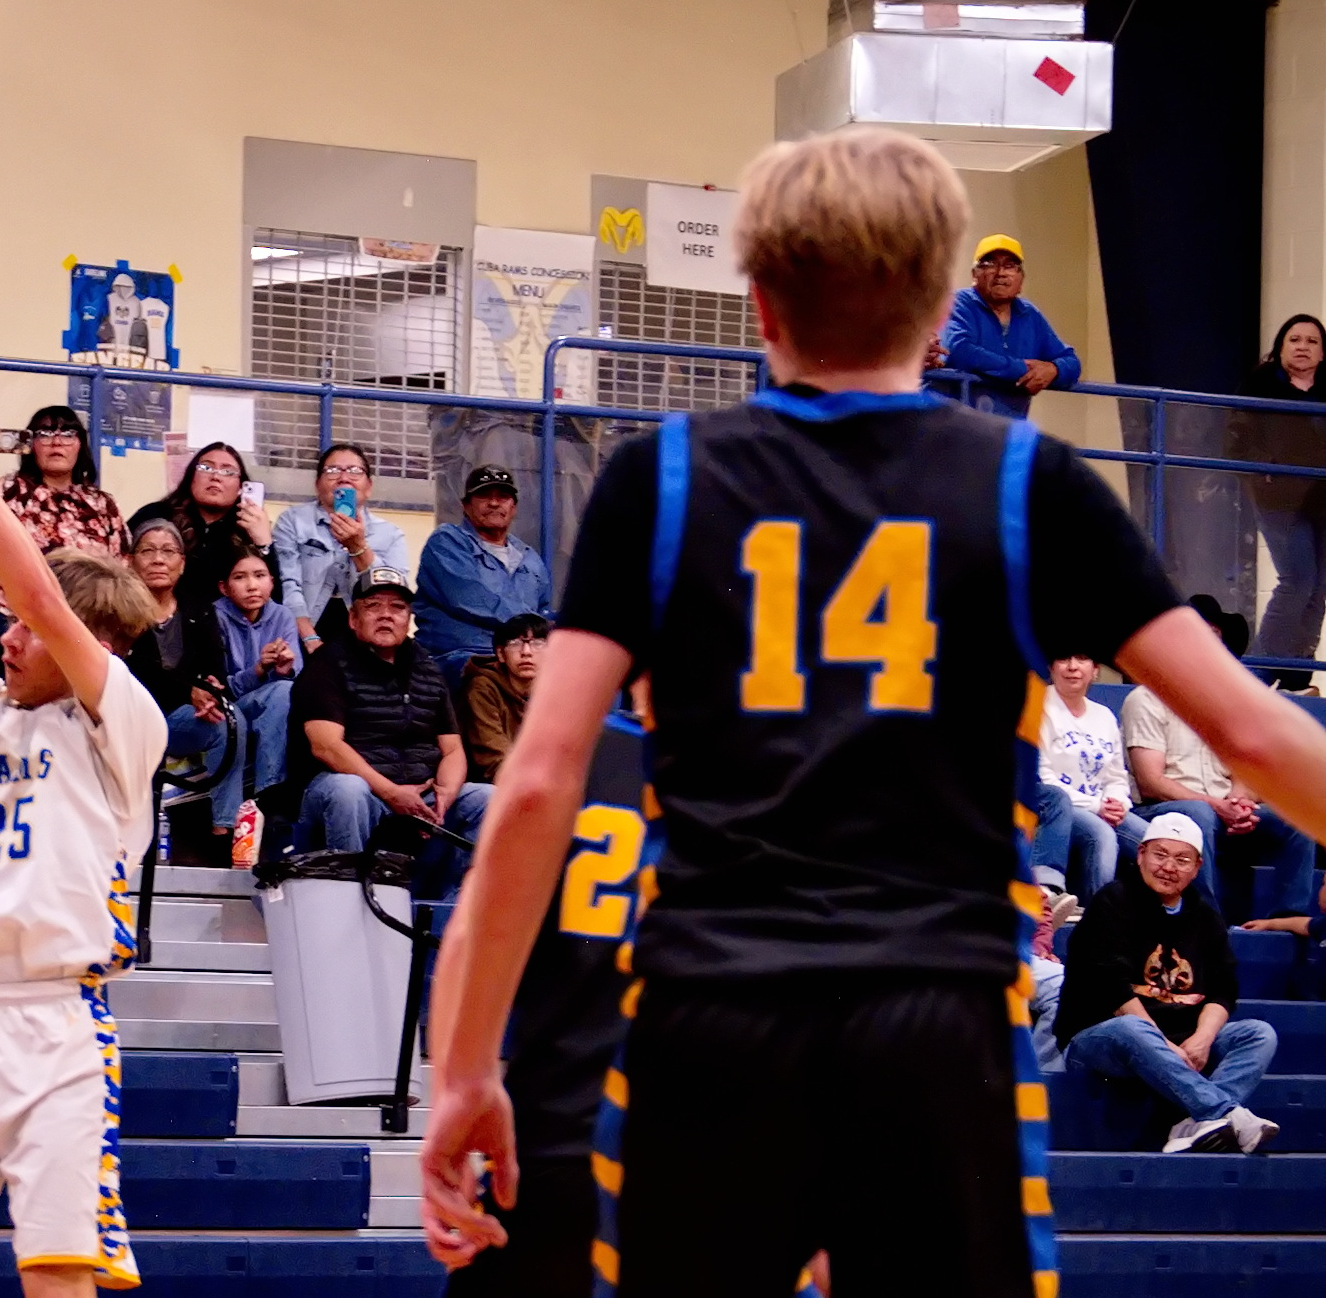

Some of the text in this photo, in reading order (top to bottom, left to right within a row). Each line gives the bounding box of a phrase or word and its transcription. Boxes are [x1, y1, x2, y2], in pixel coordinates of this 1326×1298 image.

[677, 220, 719, 236] ORDER
[682, 244, 715, 258] HERE
[512, 284, 546, 299] MENU
[742, 520, 938, 712] 14
